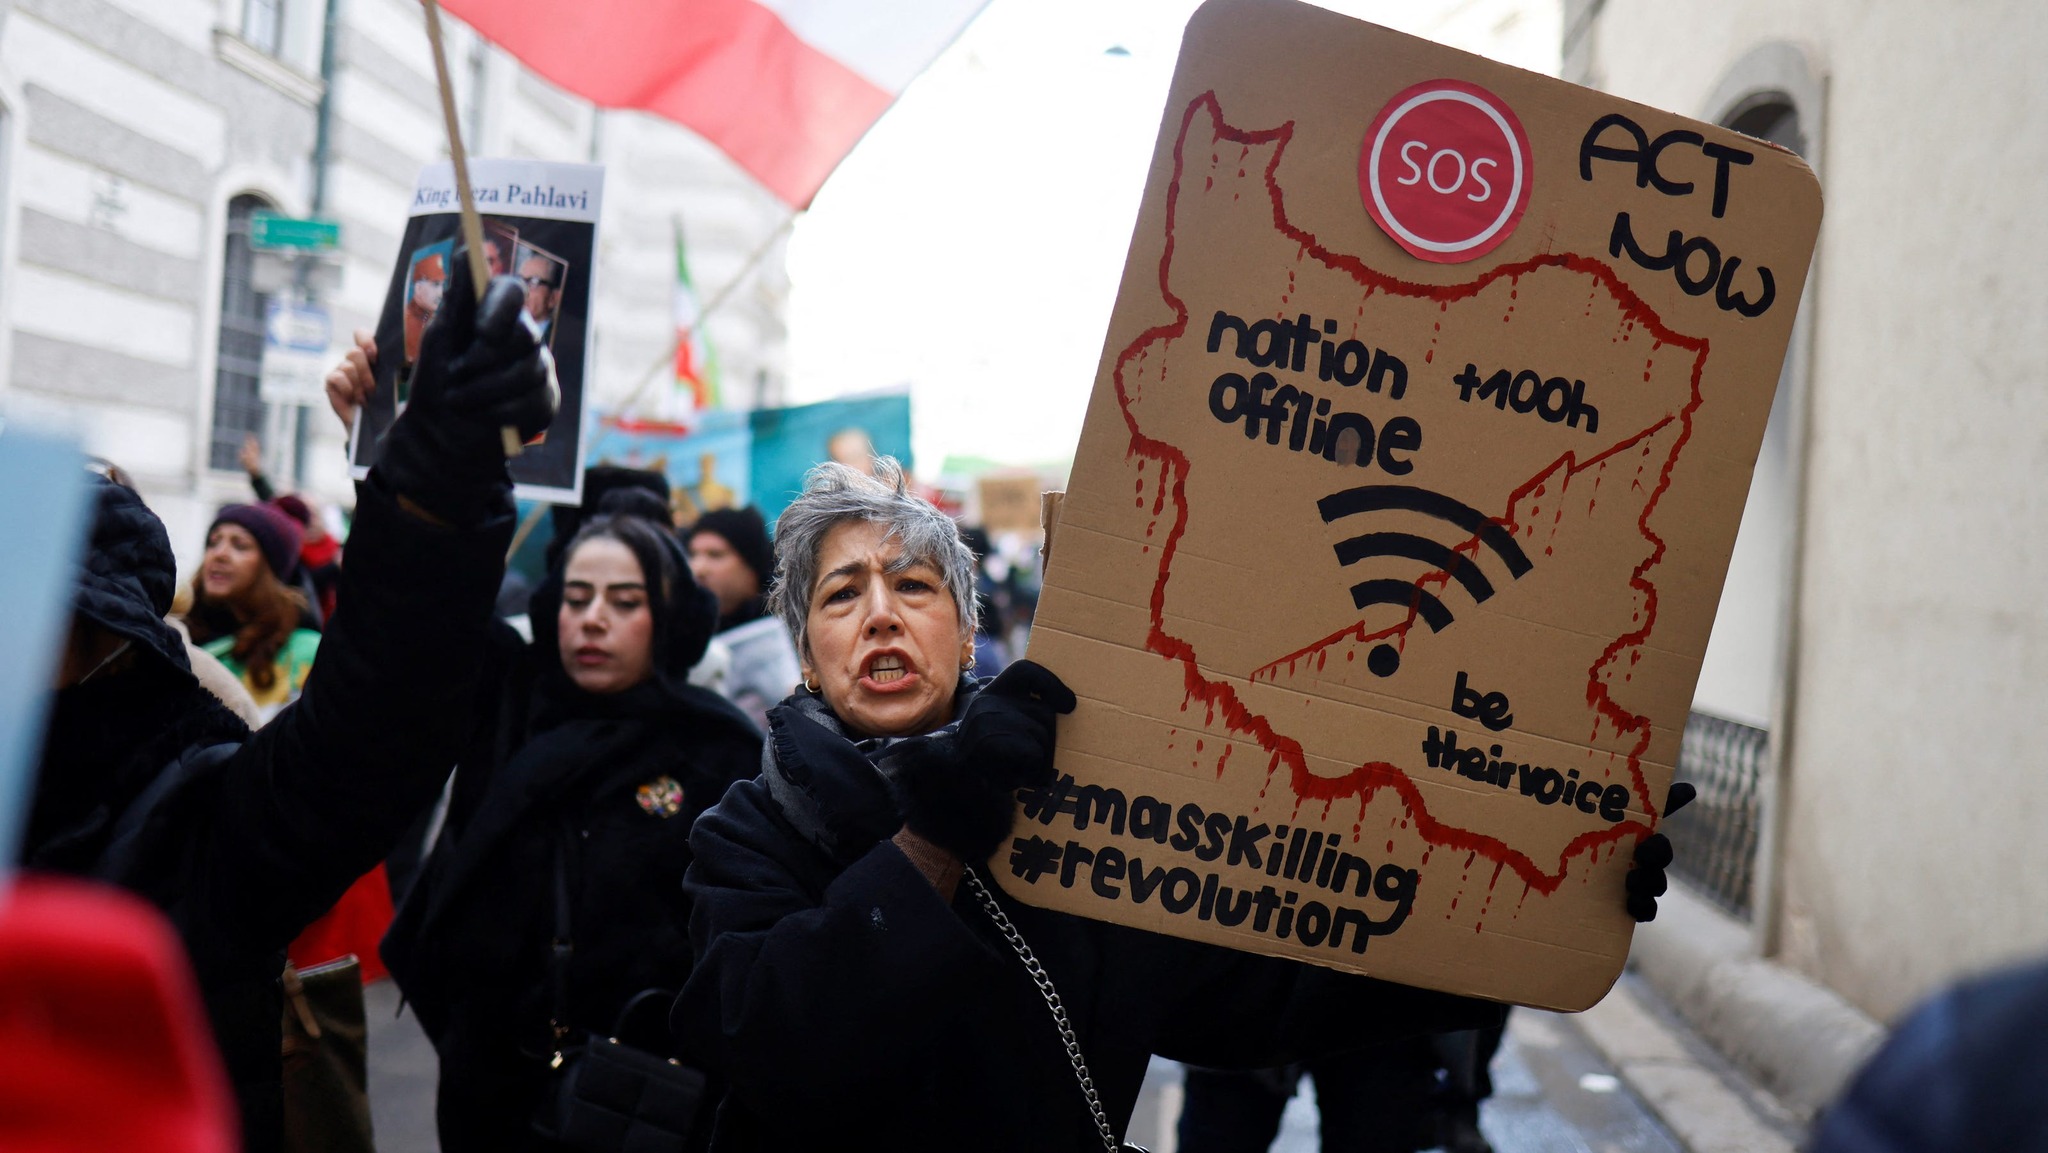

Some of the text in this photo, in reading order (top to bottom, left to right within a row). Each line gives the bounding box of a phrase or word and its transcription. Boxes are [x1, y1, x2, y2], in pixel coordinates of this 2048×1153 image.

[414, 184, 587, 210] King eza Pahlavi
[1397, 140, 1498, 202] SOS
[1579, 113, 1754, 218] ACT
[1609, 212, 1776, 317] NOW
[1206, 310, 1409, 400] nation
[1453, 363, 1600, 434] +100h
[1208, 372, 1423, 476] offline
[1451, 671, 1514, 732] be
[1009, 834, 1370, 954] #revolution
